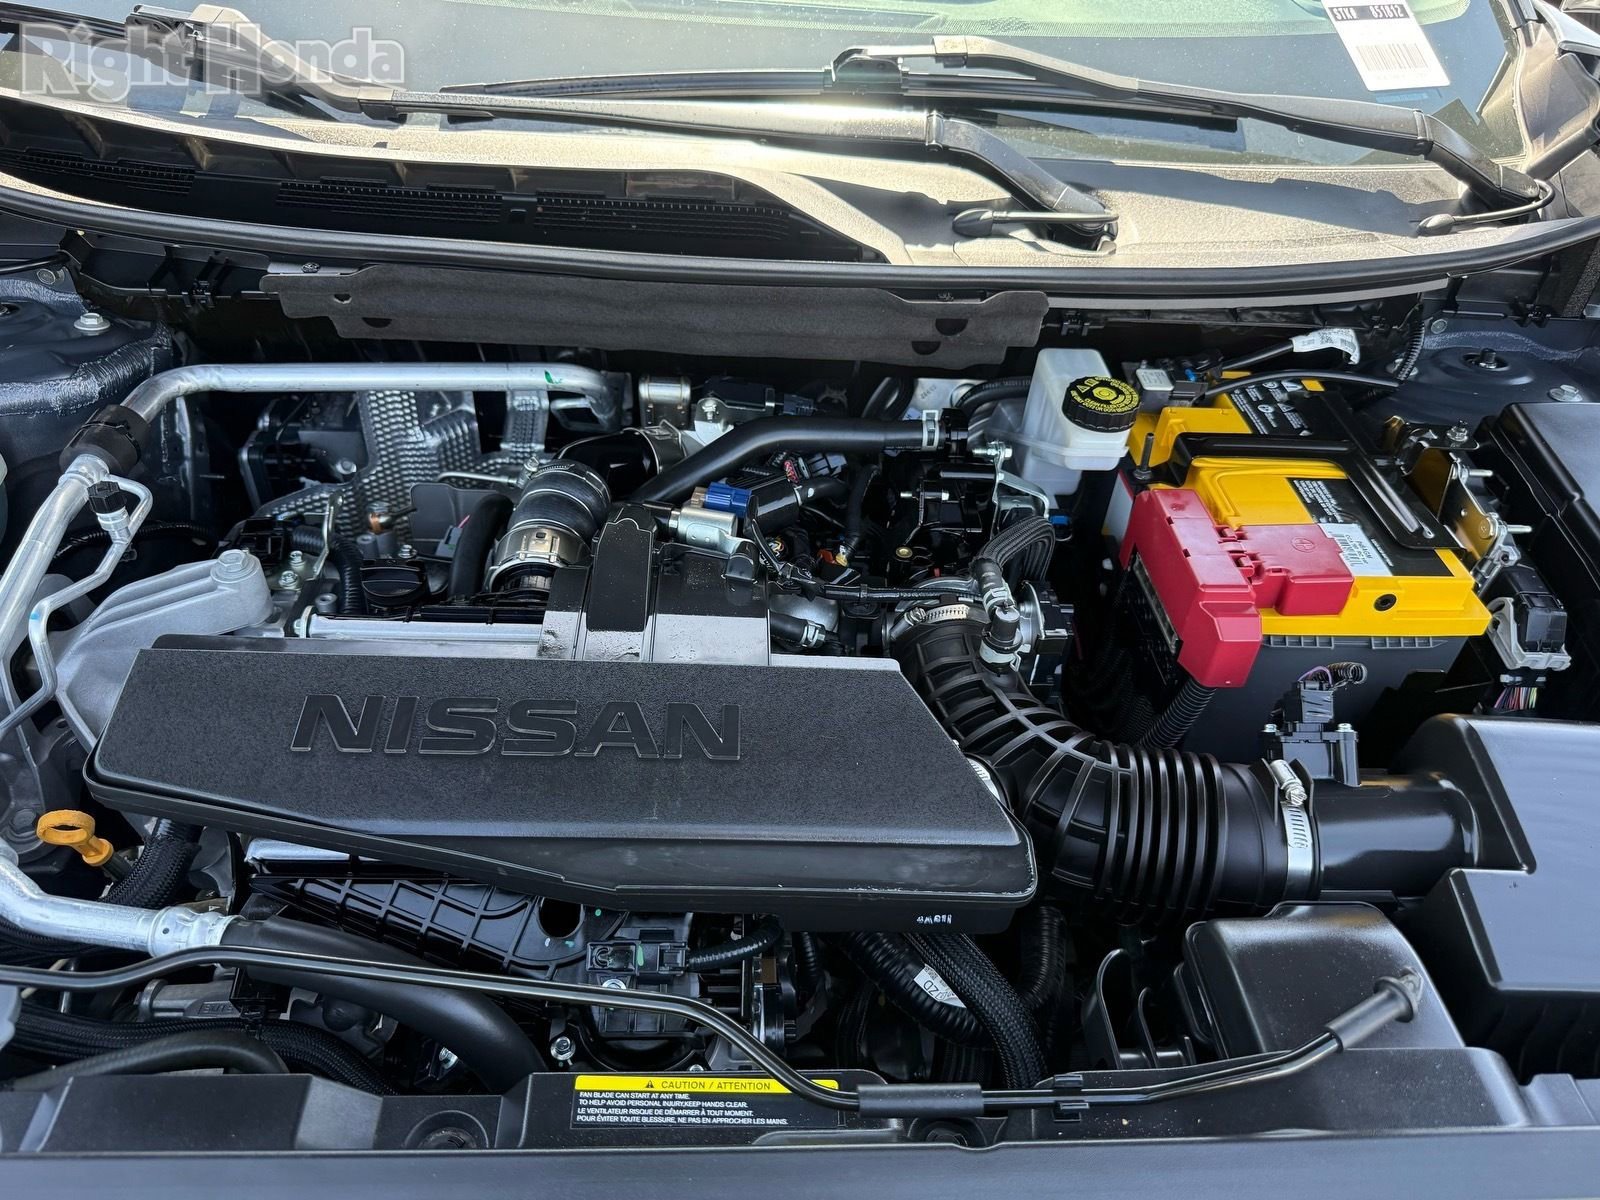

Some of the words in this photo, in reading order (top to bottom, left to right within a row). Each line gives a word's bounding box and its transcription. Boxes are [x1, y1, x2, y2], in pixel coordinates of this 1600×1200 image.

[291, 694, 742, 760] NISSAN
[662, 1081, 705, 1089] CAUTION
[717, 1082, 770, 1090] ATTENTION
[596, 1114, 619, 1122] ÉVITER
